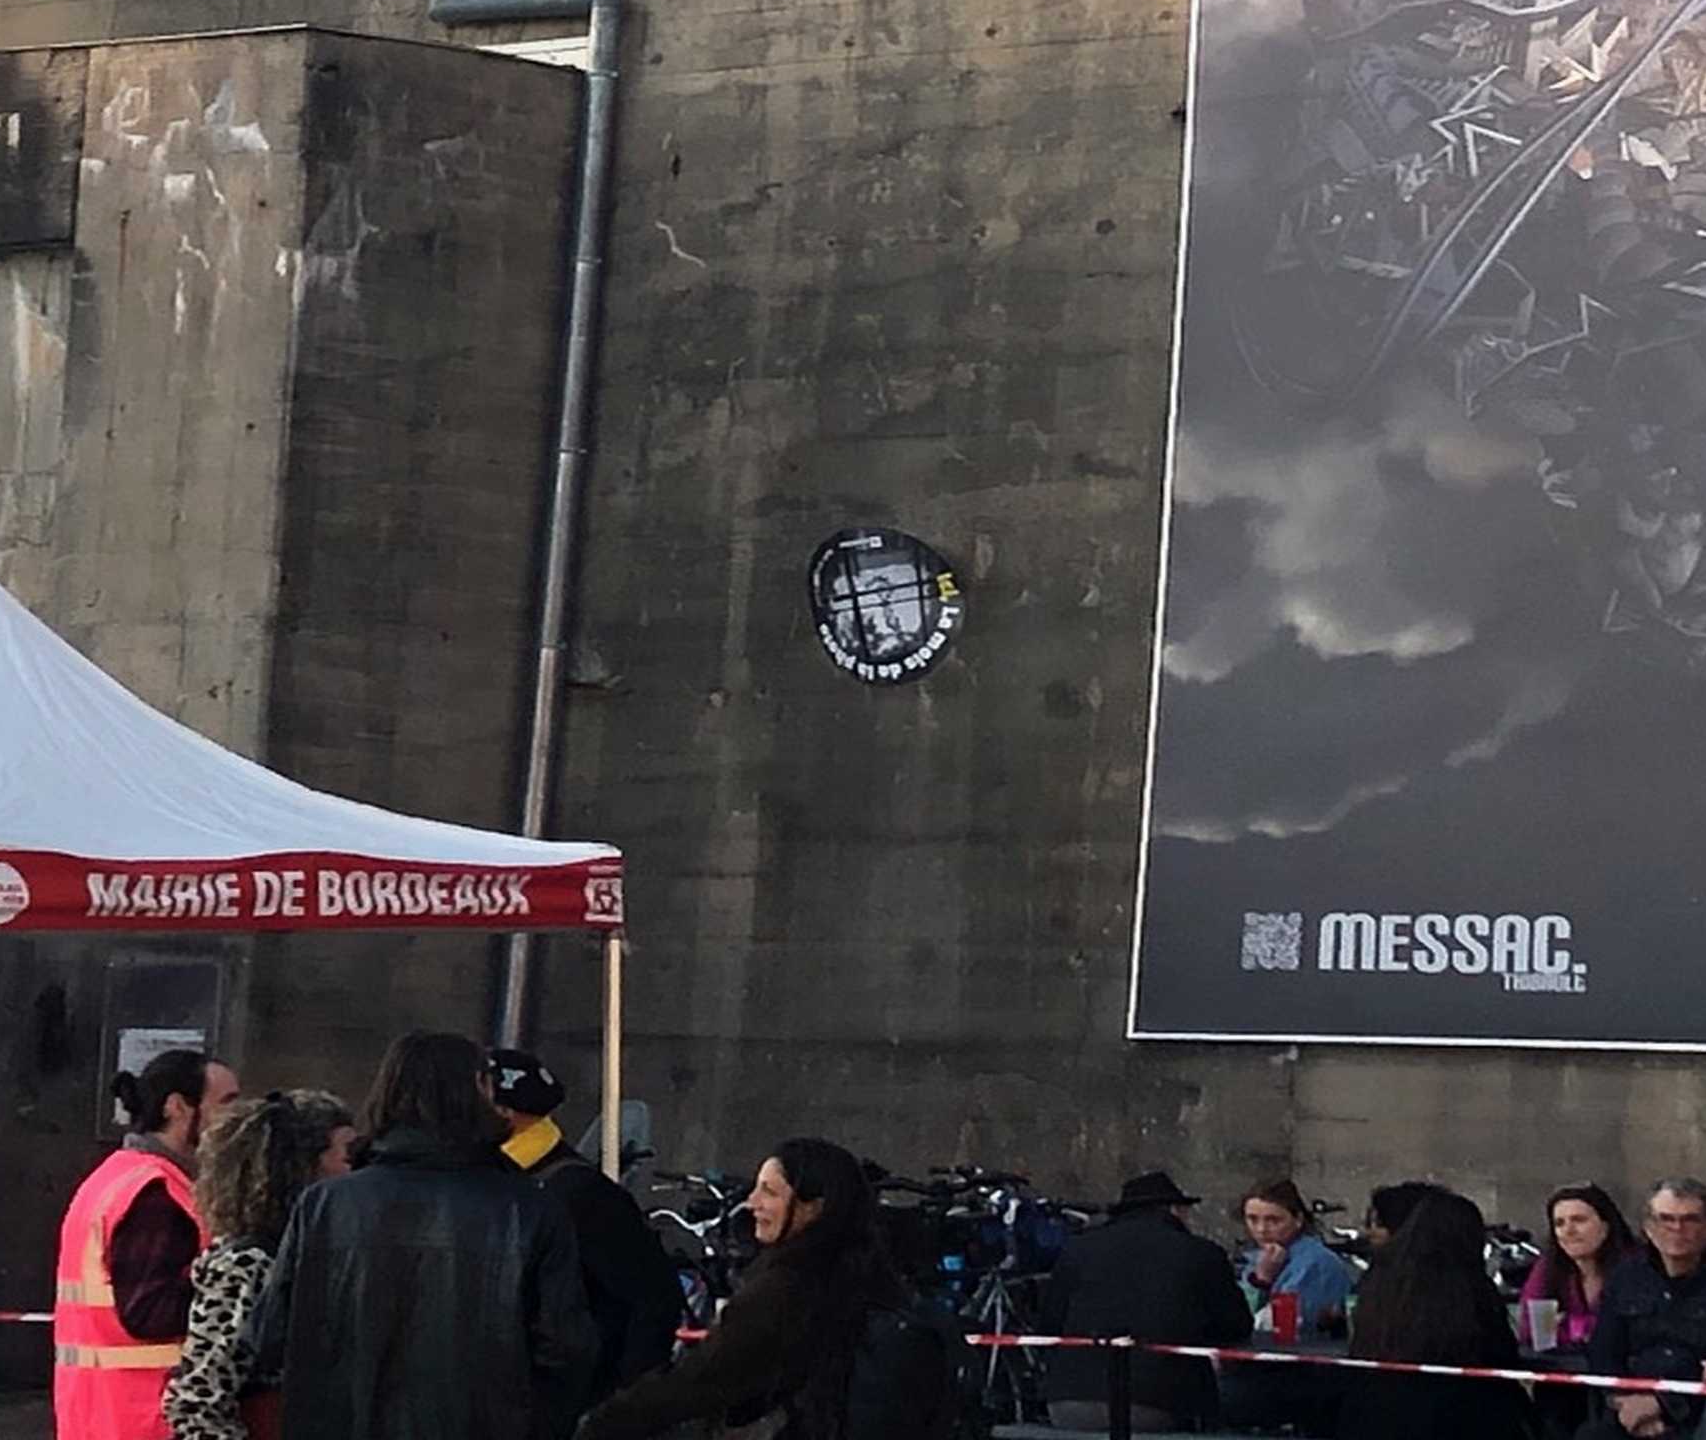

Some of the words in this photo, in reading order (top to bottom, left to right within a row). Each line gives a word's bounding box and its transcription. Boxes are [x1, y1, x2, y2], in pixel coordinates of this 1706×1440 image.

[87, 872, 240, 918] MAIRIE
[253, 871, 305, 917] DE
[318, 870, 532, 917] BORDEAUX
